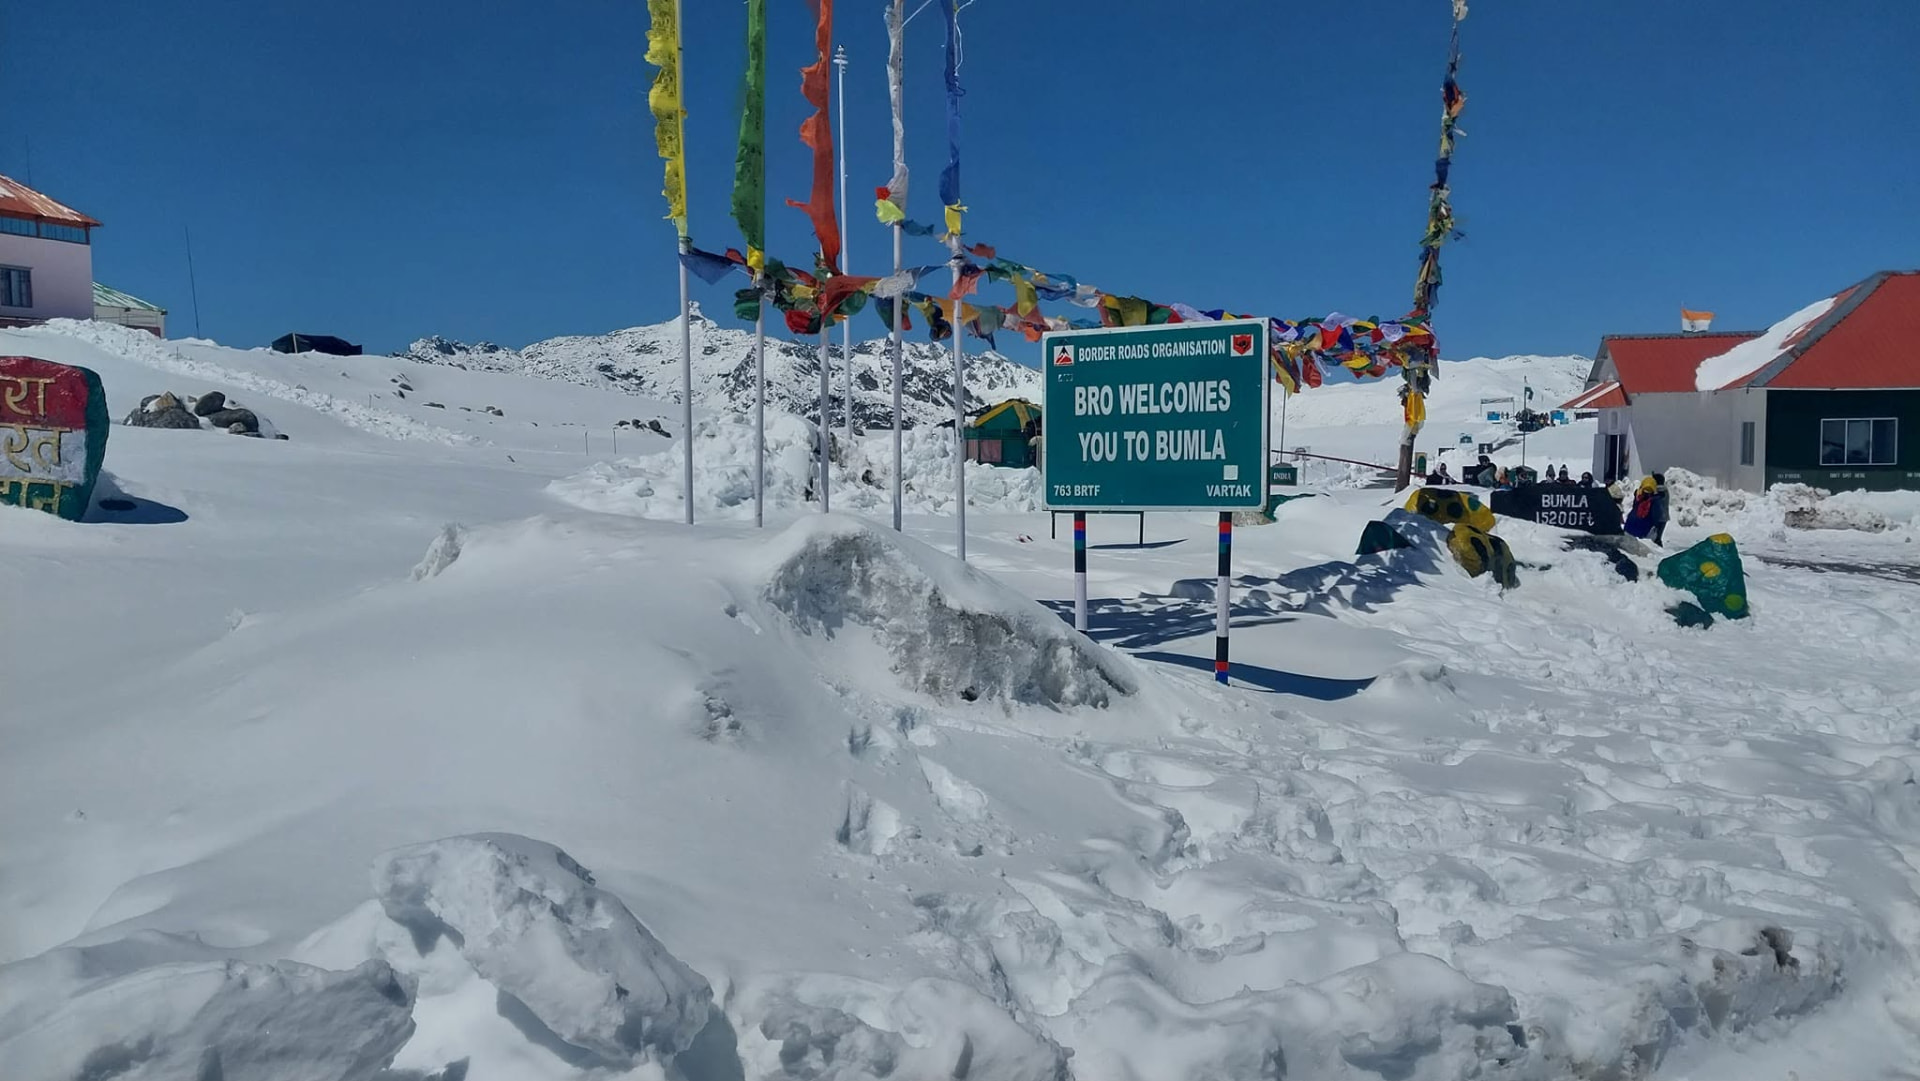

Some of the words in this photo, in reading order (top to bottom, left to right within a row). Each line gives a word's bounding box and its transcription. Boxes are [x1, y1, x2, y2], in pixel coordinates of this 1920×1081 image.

[1078, 345, 1116, 362] BORDER
[1118, 343, 1150, 360] ROADS
[1152, 339, 1226, 359] ORGANISATION
[0, 375, 56, 417] रा
[1074, 385, 1114, 416] BRO
[1118, 379, 1231, 415] WELCOMES
[0, 422, 72, 473] रत
[1078, 431, 1118, 462] YOU
[1123, 430, 1150, 462] TO
[1156, 428, 1227, 461] BUMLA
[1053, 485, 1072, 497] 763
[1074, 485, 1101, 497] BRTF
[1205, 484, 1252, 497] VARTAK
[1541, 494, 1588, 508] BUMLA
[1536, 511, 1595, 526] 15200Ft
